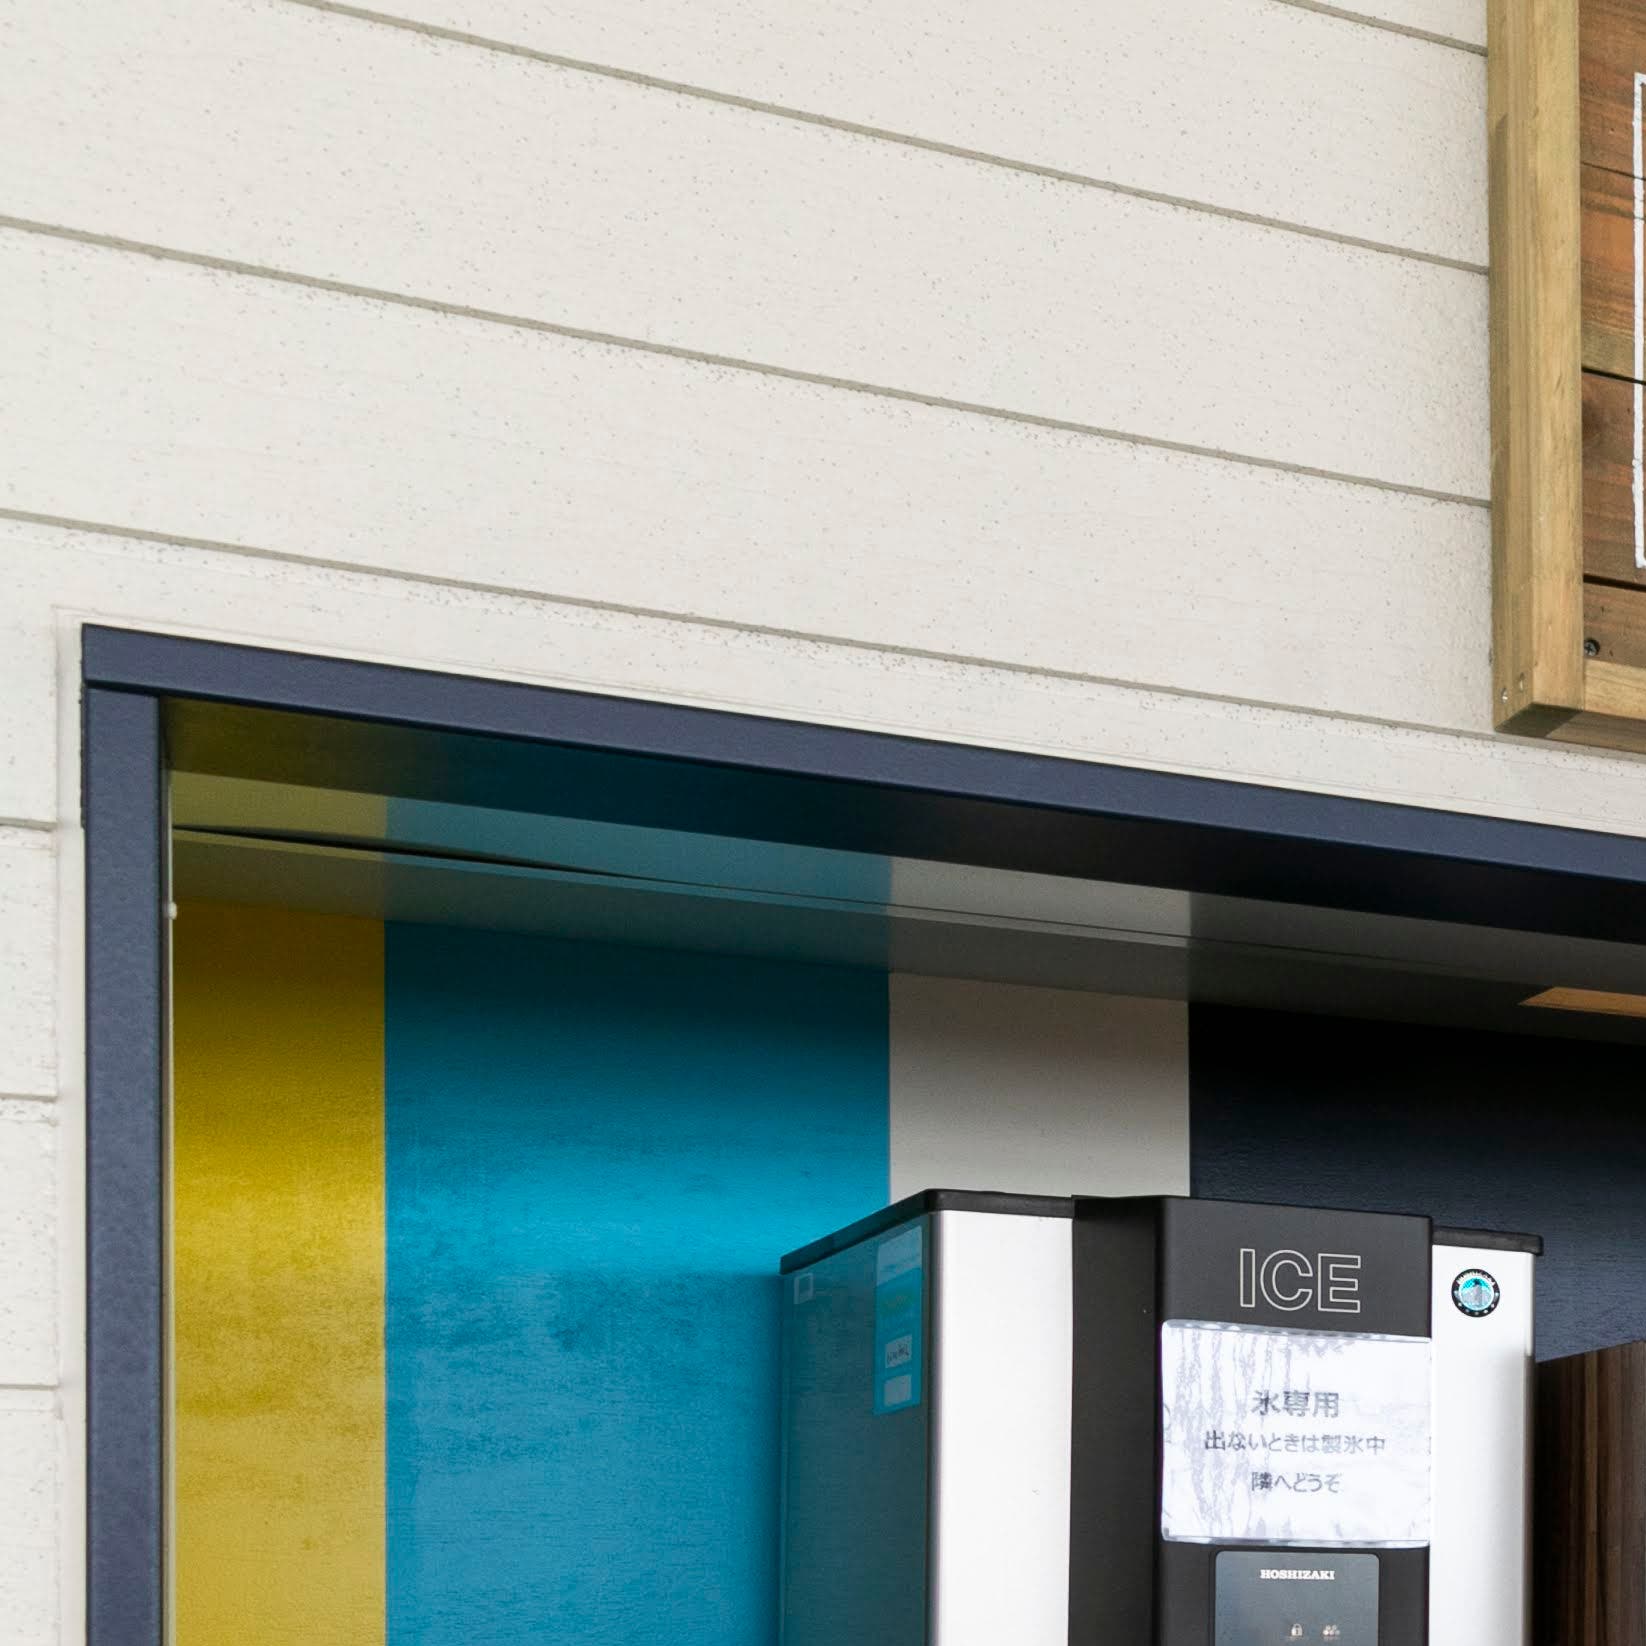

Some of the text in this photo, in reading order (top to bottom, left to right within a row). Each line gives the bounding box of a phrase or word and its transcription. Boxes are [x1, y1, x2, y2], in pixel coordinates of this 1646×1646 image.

[1238, 1247, 1362, 1314] ICE
[1250, 1389, 1340, 1419] 氷専用
[1203, 1430, 1386, 1456] 出ないときは製氷中
[1250, 1471, 1343, 1495] 隣へどうぞ
[1260, 1569, 1335, 1580] HOSHIZAKI
